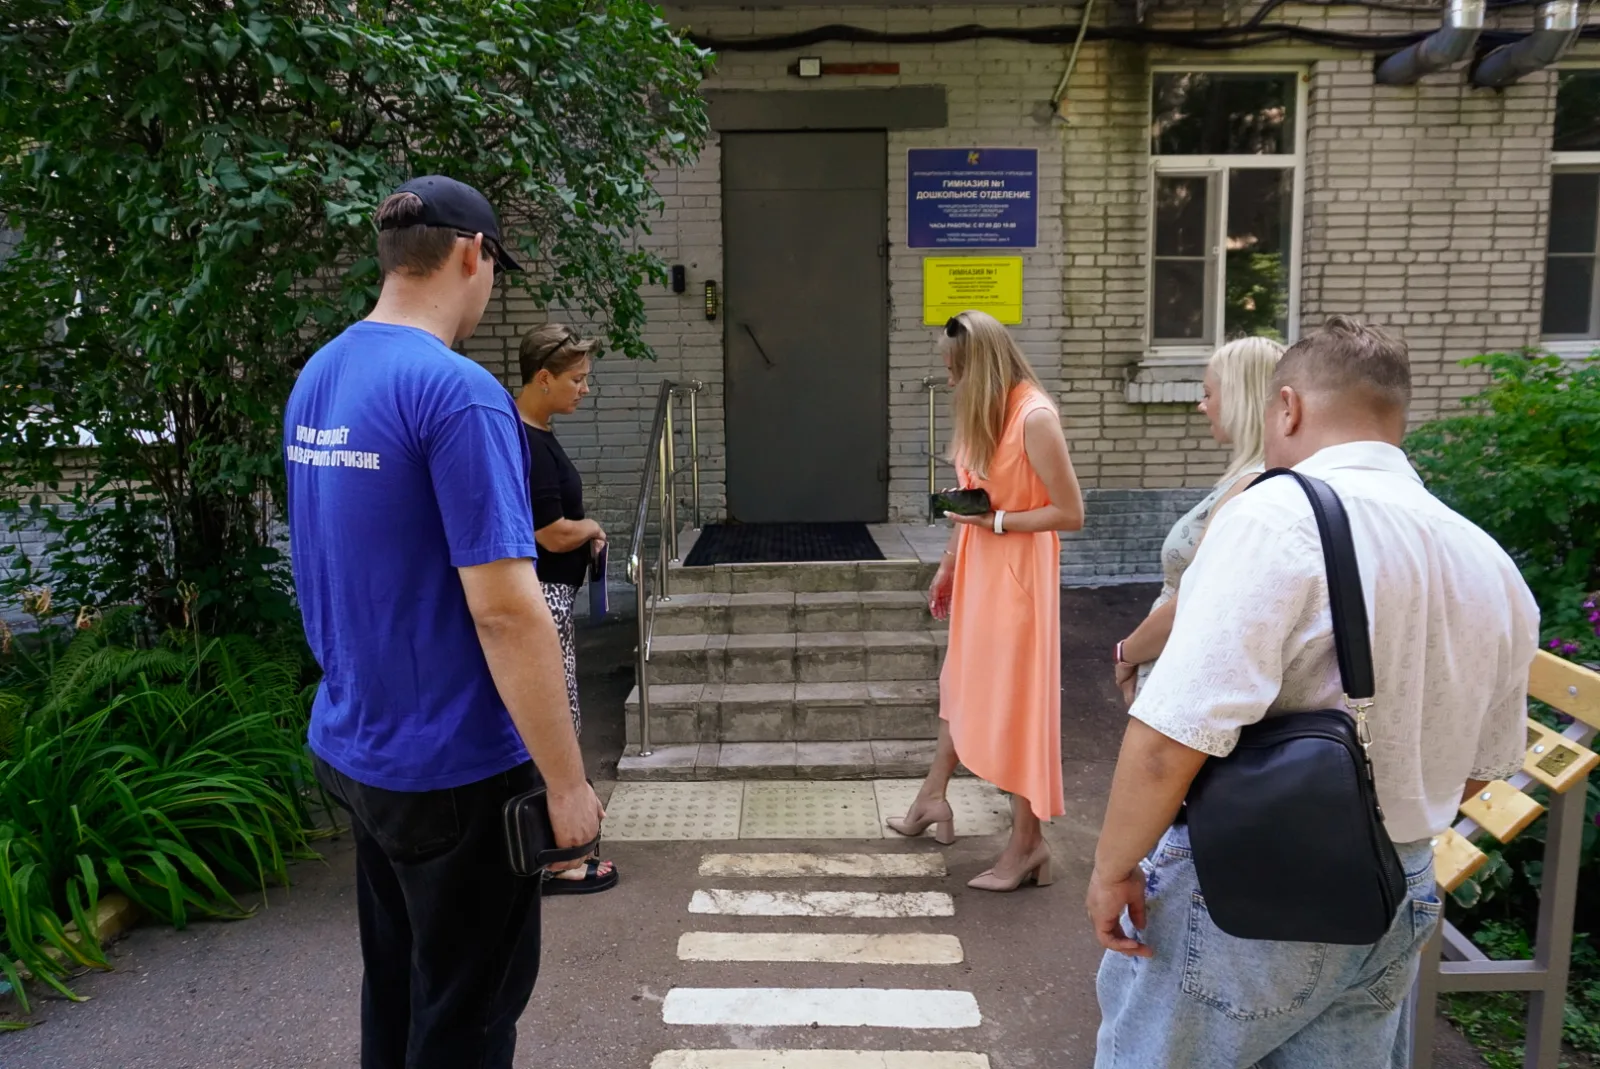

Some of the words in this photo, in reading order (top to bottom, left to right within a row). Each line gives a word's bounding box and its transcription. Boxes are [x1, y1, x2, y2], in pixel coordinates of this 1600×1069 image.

[943, 179, 989, 188] ГИМНАЗИЯ
[991, 179, 1005, 188] №1
[916, 190, 978, 200] ДОШКОЛЬНОЕ
[979, 190, 1031, 200] ОТДЕЛЕНИЕ
[949, 268, 985, 276] ГИМНАЗИЯ
[331, 450, 380, 470] ОТЧИЗНЕ
